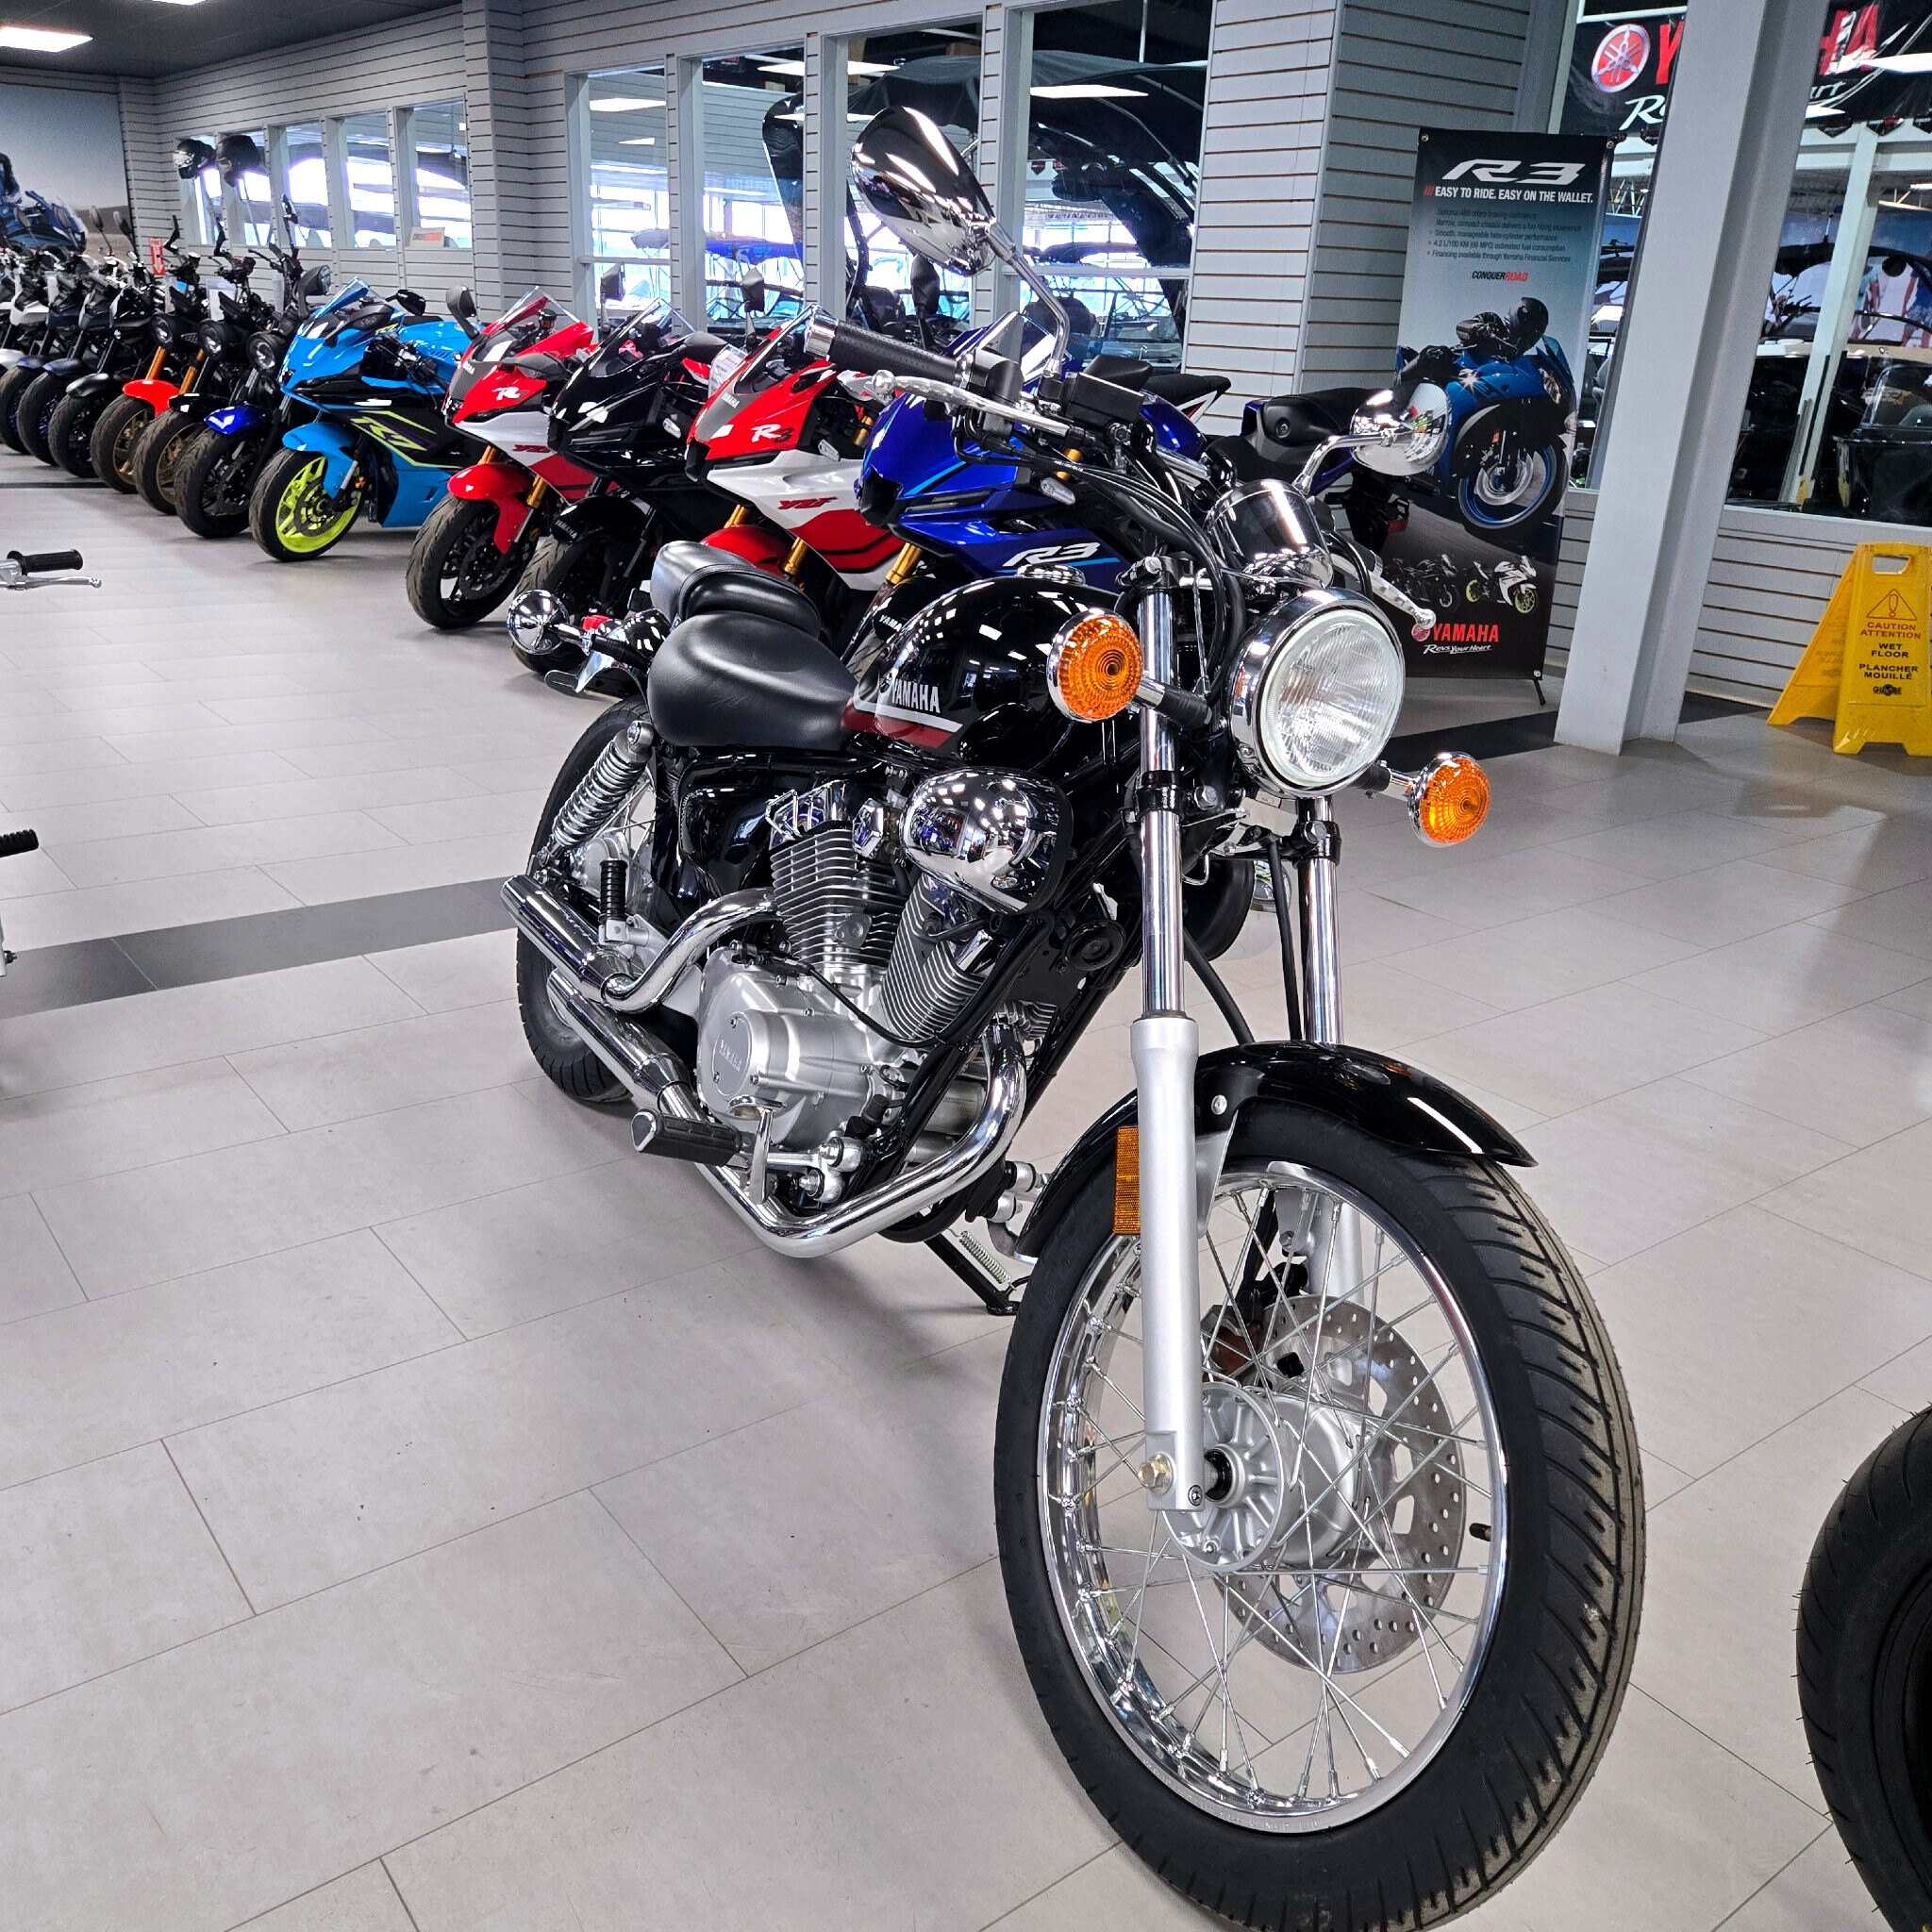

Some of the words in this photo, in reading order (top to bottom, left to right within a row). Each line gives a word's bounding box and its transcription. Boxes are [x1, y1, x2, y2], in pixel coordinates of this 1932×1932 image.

[1441, 158, 1586, 186] R3
[1435, 186, 1459, 198] EASY
[1460, 188, 1472, 198] TO
[1474, 188, 1496, 200] RIDE.
[1498, 190, 1523, 201] EASY
[1524, 191, 1537, 201] ON
[1539, 191, 1556, 202] THE
[1557, 192, 1593, 204] WALLET.
[1432, 250, 1457, 259] Financing
[750, 424, 795, 443] R3
[1002, 541, 1101, 567] R3
[878, 614, 903, 632] YAMA
[1867, 622, 1916, 631] CAUTION
[1433, 623, 1499, 642] YAMAHA
[1860, 629, 1921, 639] ATTENTION
[1423, 643, 1451, 655] Revs
[1450, 644, 1470, 655] Your
[1871, 650, 1909, 658] FLOOR
[1858, 663, 1918, 672] PLANCHER
[1864, 672, 1912, 680] MOUILLÉ
[891, 678, 941, 714] YAMAHA
